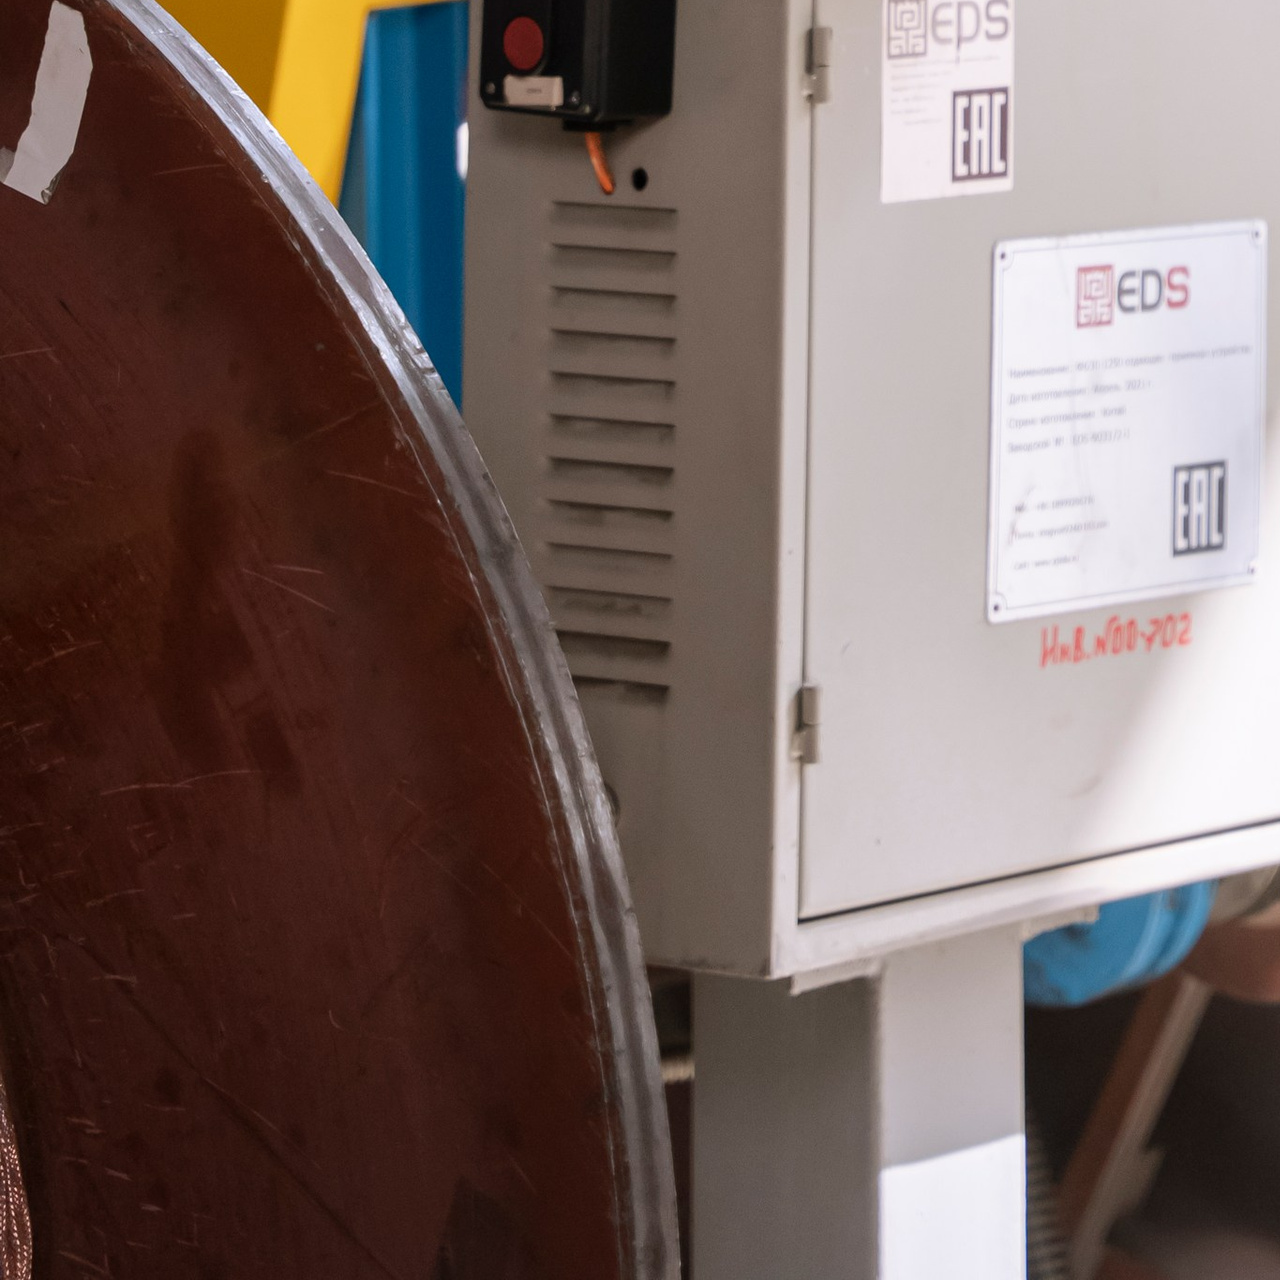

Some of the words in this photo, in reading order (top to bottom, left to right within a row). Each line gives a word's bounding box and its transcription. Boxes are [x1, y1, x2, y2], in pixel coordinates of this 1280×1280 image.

[953, 90, 1007, 178] EAC
[1116, 265, 1191, 314] EDS
[1174, 465, 1224, 551] EAC
